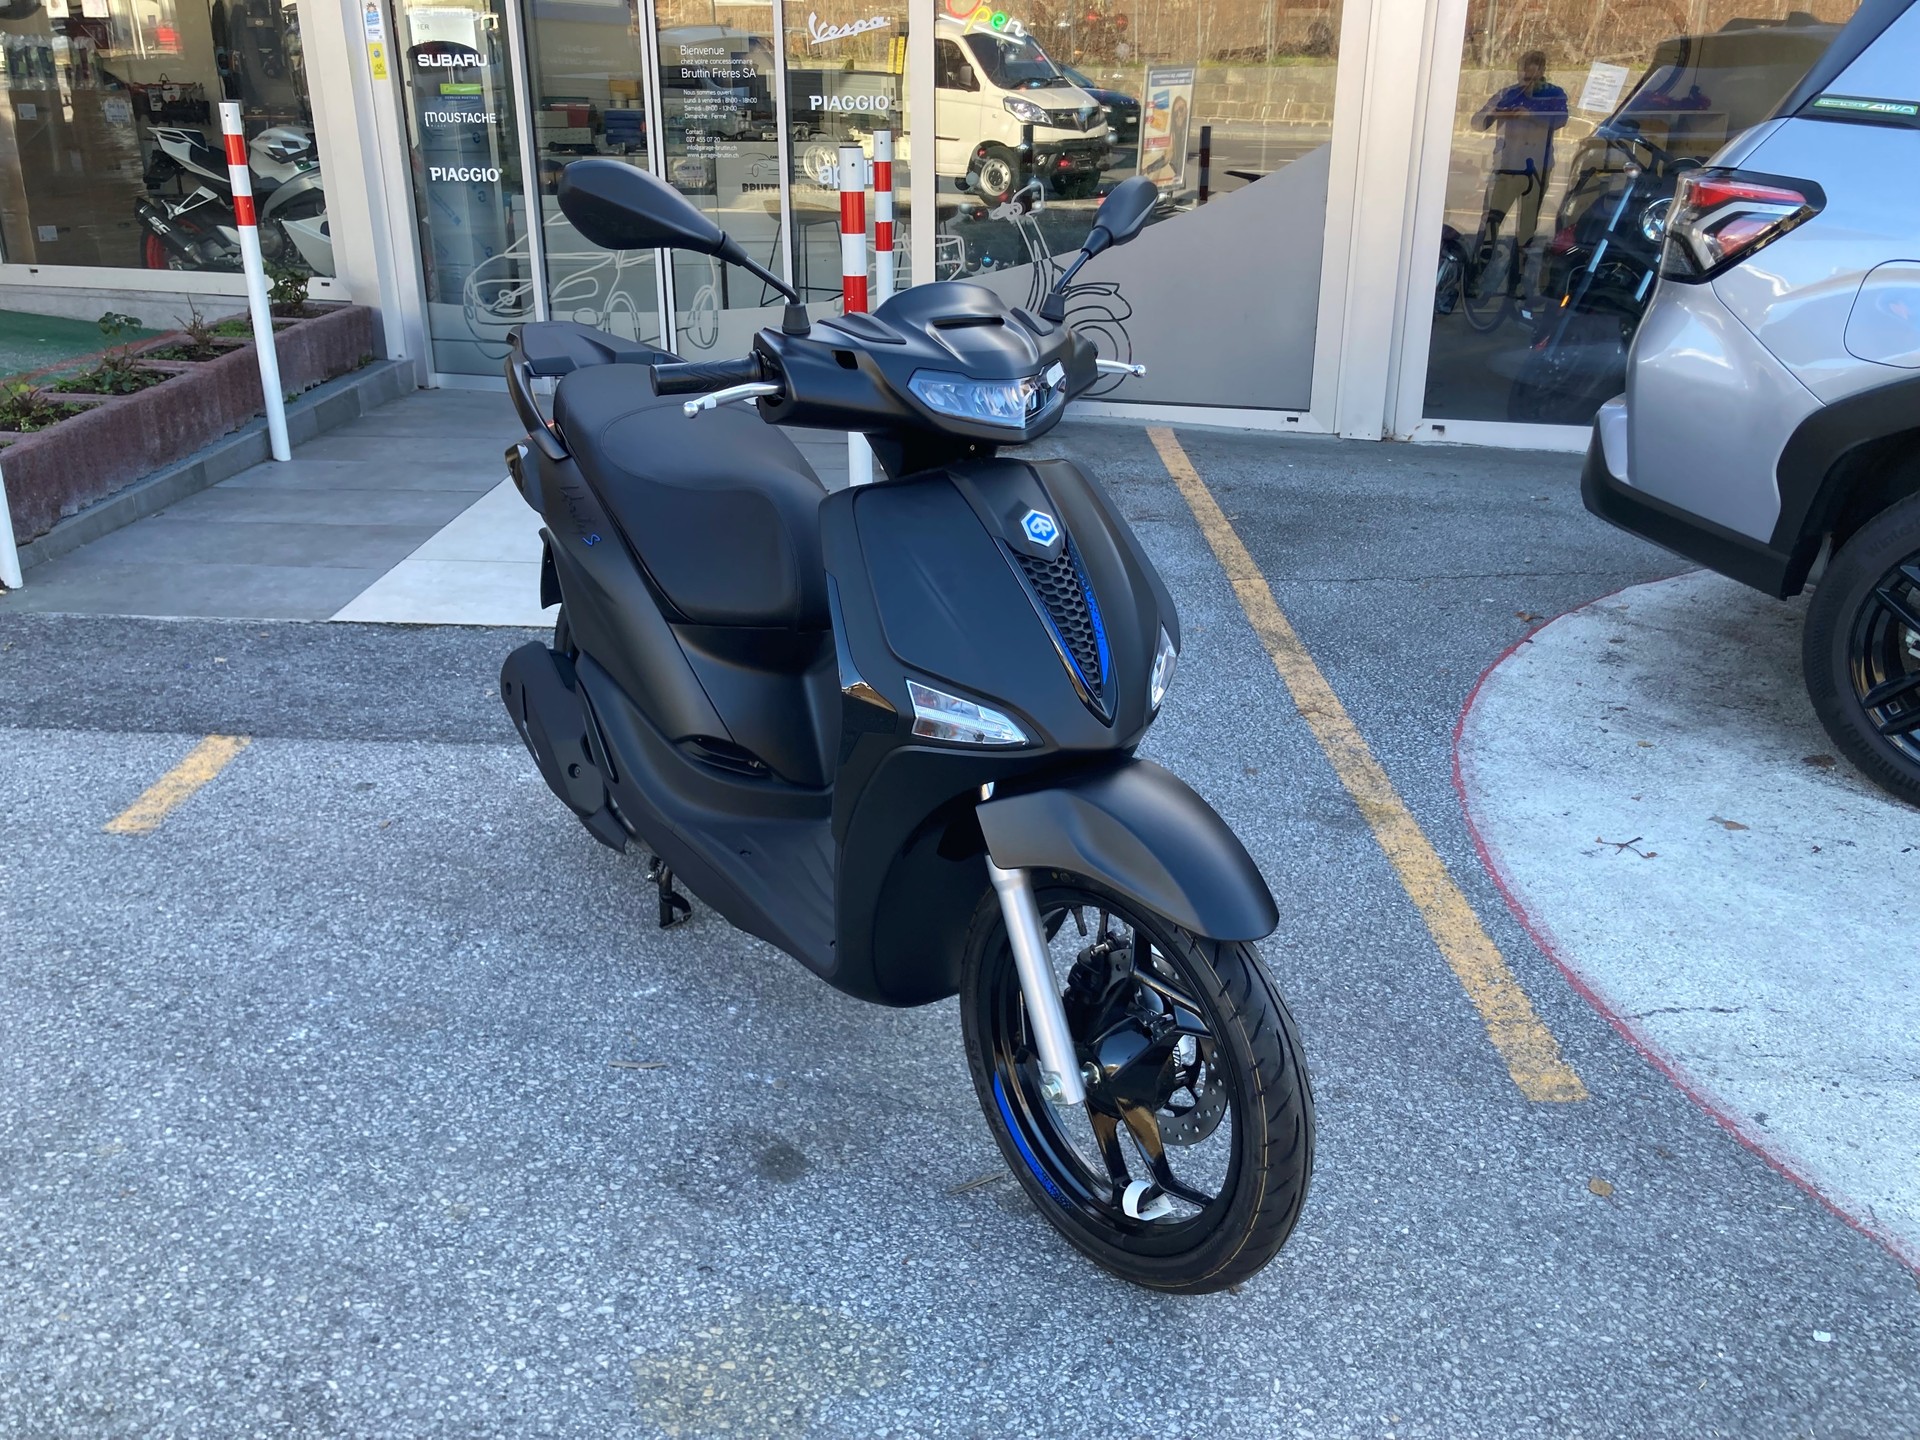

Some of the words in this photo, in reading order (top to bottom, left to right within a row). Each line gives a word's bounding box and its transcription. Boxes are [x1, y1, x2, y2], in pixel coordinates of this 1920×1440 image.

[808, 11, 891, 45] Vespa
[680, 44, 725, 56] Bienvenue
[417, 53, 488, 67] SUBARU
[681, 67, 711, 79] Bruttin
[712, 67, 741, 79] Frères
[742, 67, 757, 79] SA
[808, 95, 889, 111] PIAGGIO
[424, 111, 497, 127] MOUSTACHE
[429, 166, 500, 182] PIAGGIO
